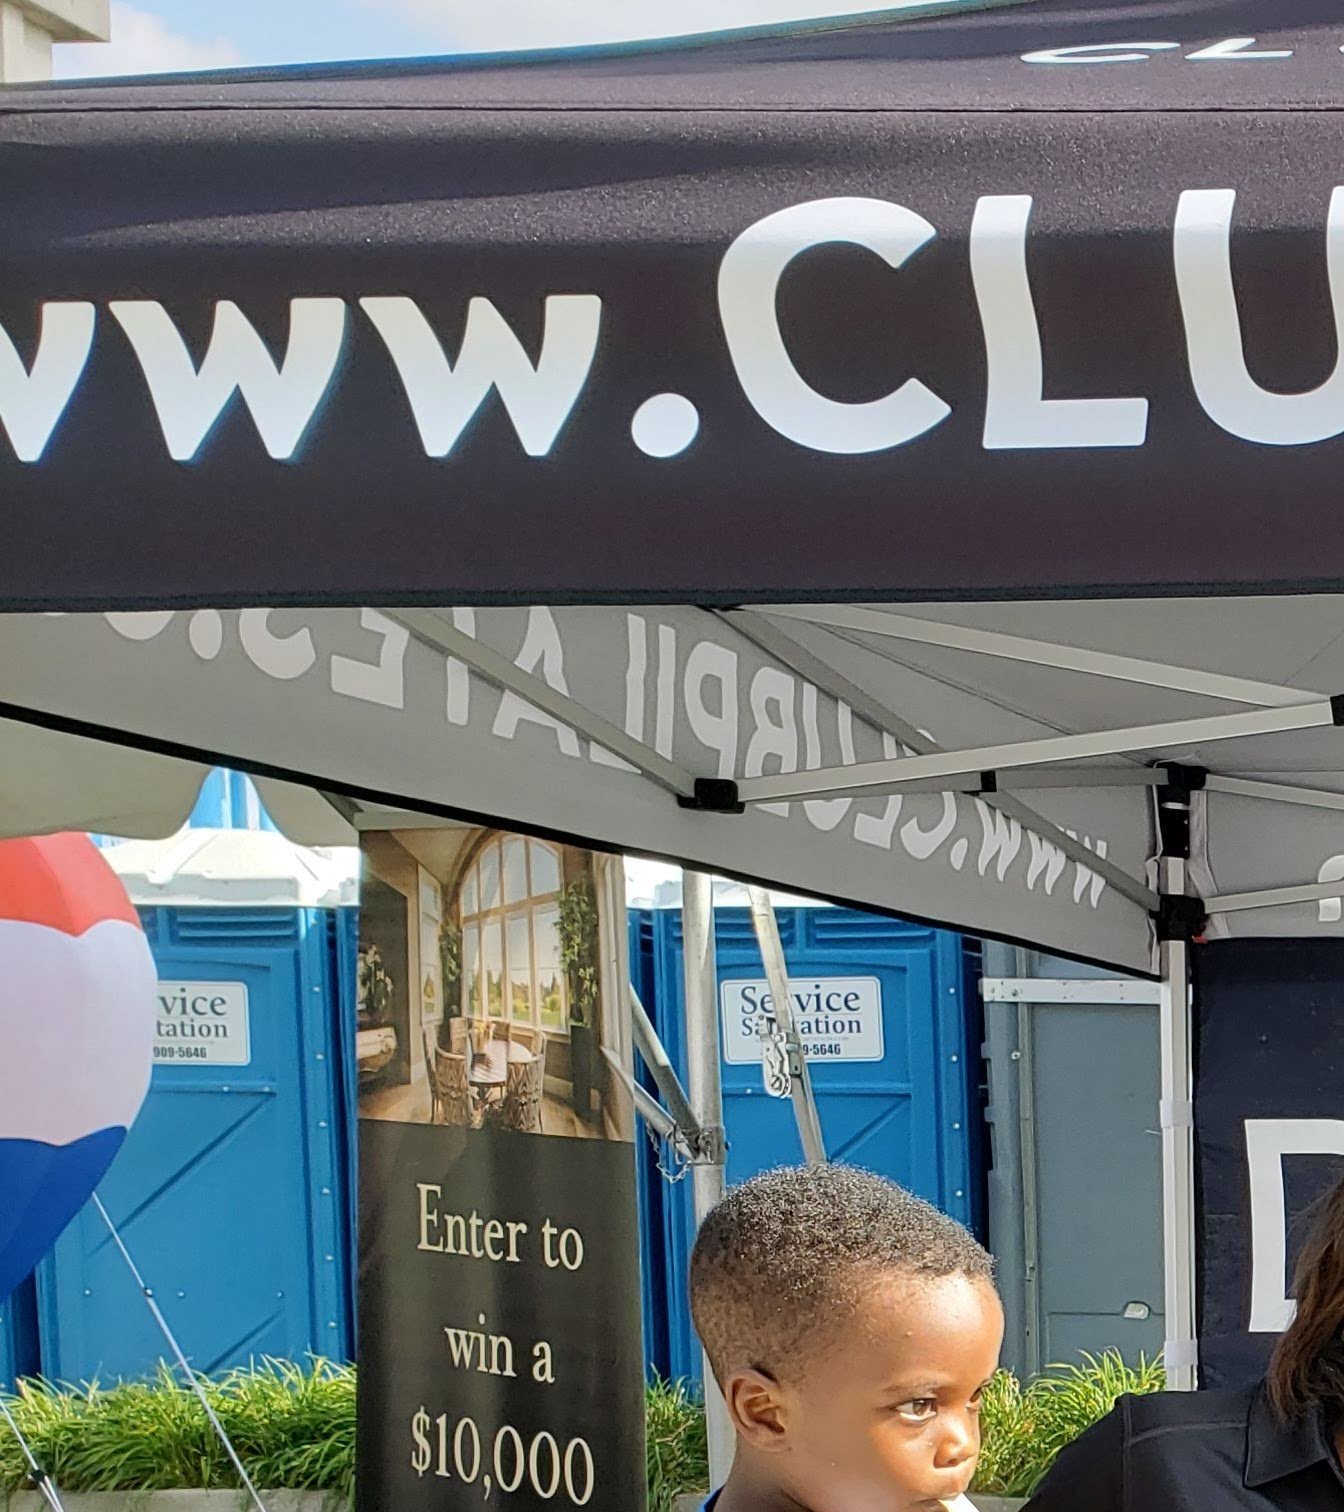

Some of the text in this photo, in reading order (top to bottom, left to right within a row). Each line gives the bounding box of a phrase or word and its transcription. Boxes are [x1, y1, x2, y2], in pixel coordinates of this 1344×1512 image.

[158, 986, 228, 1016] vice
[740, 984, 861, 1015] Sevice
[156, 1018, 229, 1039] tation
[742, 1014, 862, 1037] Sation
[415, 1182, 585, 1272] Enter to
[444, 1312, 556, 1384] win a
[410, 1405, 596, 1507] $10,000
